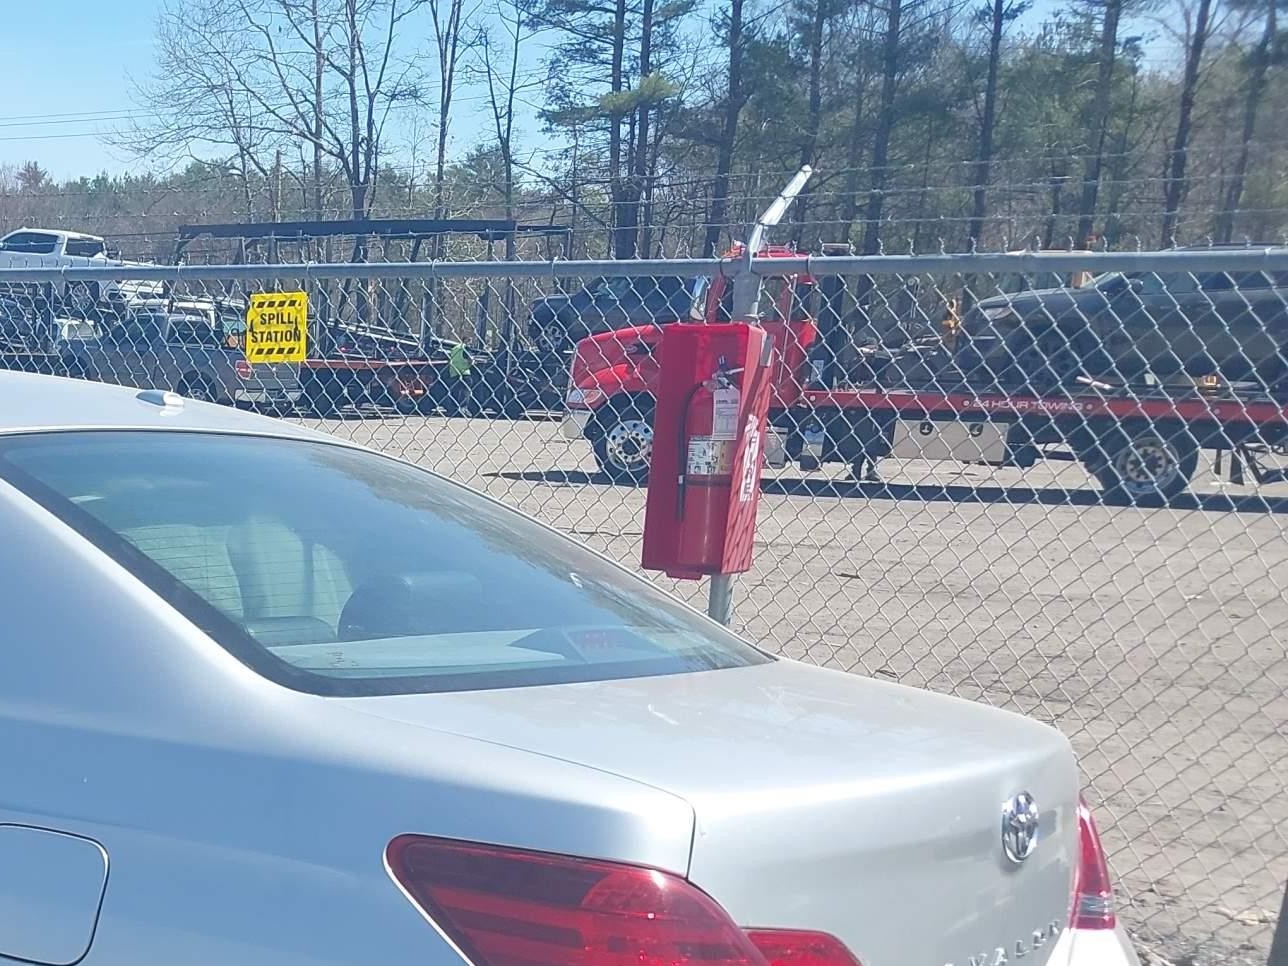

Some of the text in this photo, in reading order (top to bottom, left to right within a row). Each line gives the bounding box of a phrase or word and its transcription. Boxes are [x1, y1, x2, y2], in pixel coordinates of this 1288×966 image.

[260, 312, 294, 325] SPILL
[251, 329, 301, 344] STATION
[972, 400, 1084, 411] 24 HOUR TOWING
